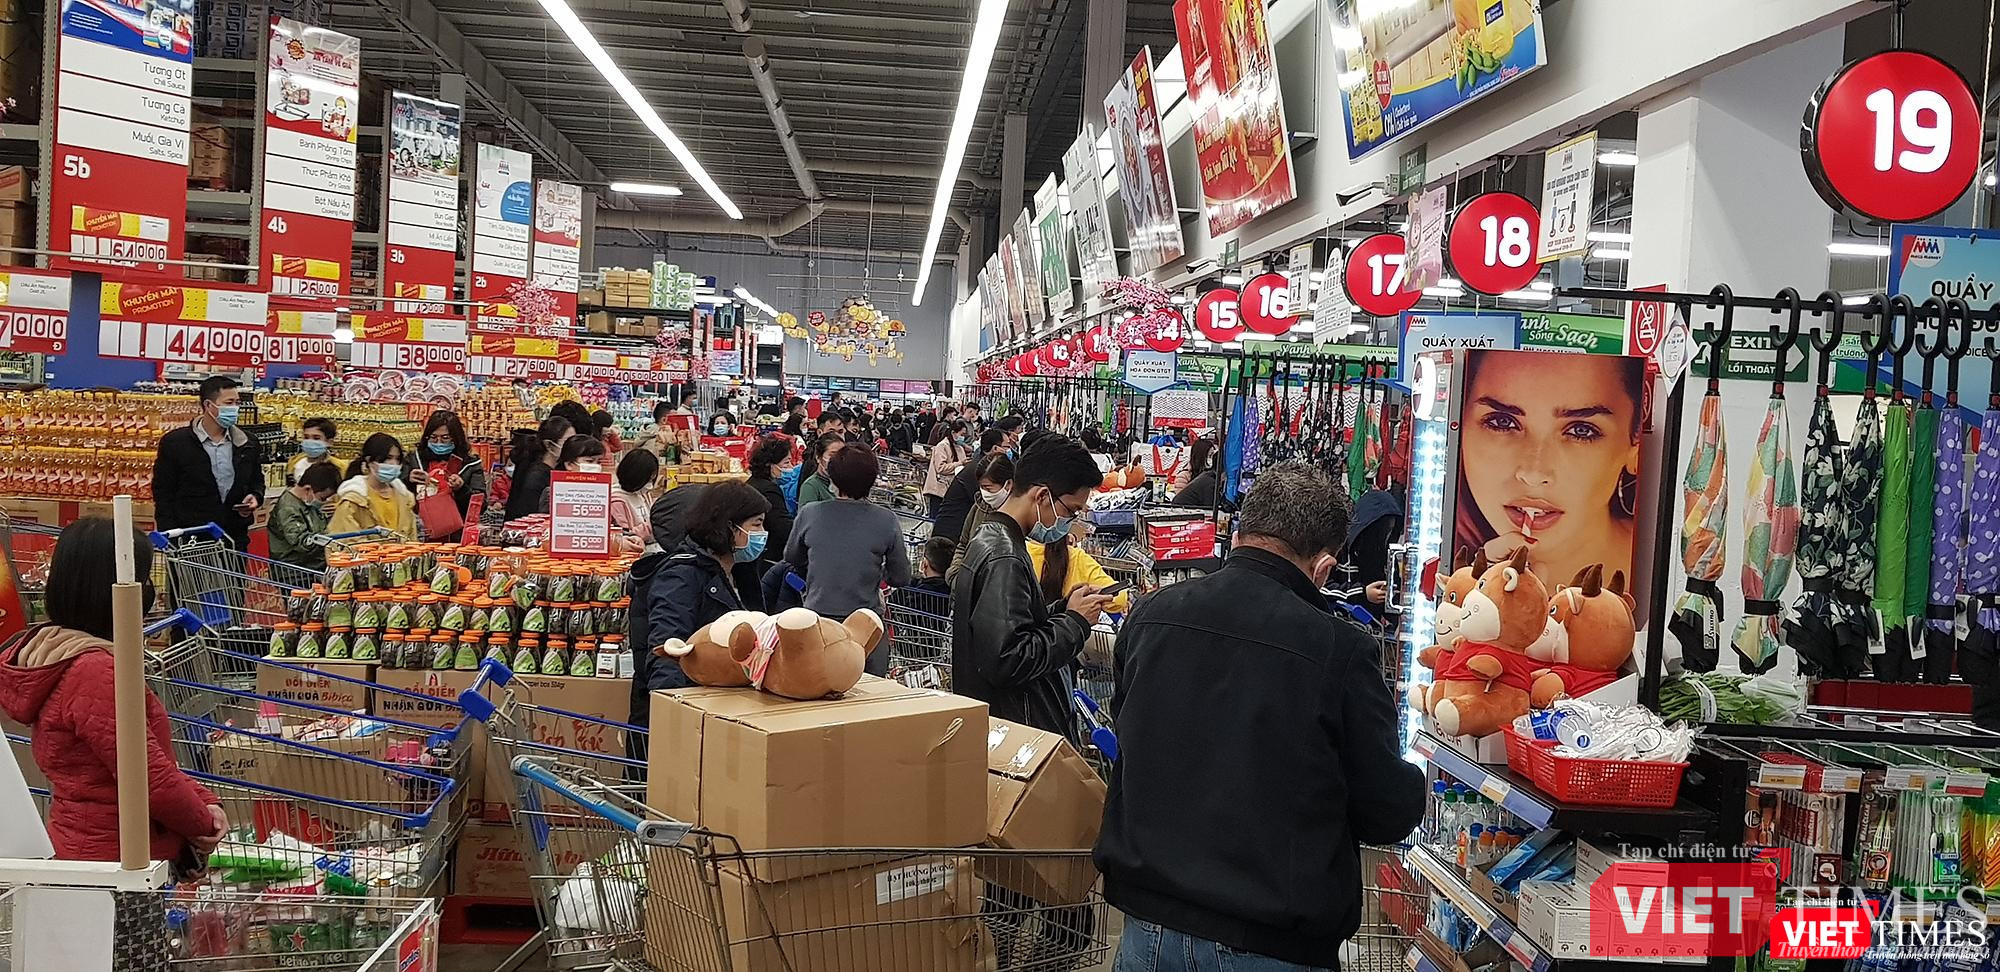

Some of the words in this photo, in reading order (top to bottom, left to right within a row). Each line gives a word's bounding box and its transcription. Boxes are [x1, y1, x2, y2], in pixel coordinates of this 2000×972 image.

[1866, 88, 1953, 173] 19
[63, 154, 91, 179] 5b
[268, 216, 288, 234] 4b
[1480, 215, 1531, 268] 18
[391, 249, 405, 264] 3b
[475, 276, 488, 288] 2b
[1368, 254, 1405, 296] 17
[1931, 273, 1994, 300] QUẦY
[132, 298, 174, 315] PROMOTION
[1259, 286, 1289, 318] 16
[1209, 301, 1238, 328] 15
[1520, 315, 1550, 331] anh
[1460, 334, 1495, 348] XUẤT
[1529, 329, 1554, 342] Sống
[1556, 324, 1599, 348] Sạch
[1730, 336, 1773, 349] EXIT
[1728, 363, 1744, 374] LỐI
[1745, 364, 1775, 374] THOÁT
[1955, 908, 1966, 917] 40
